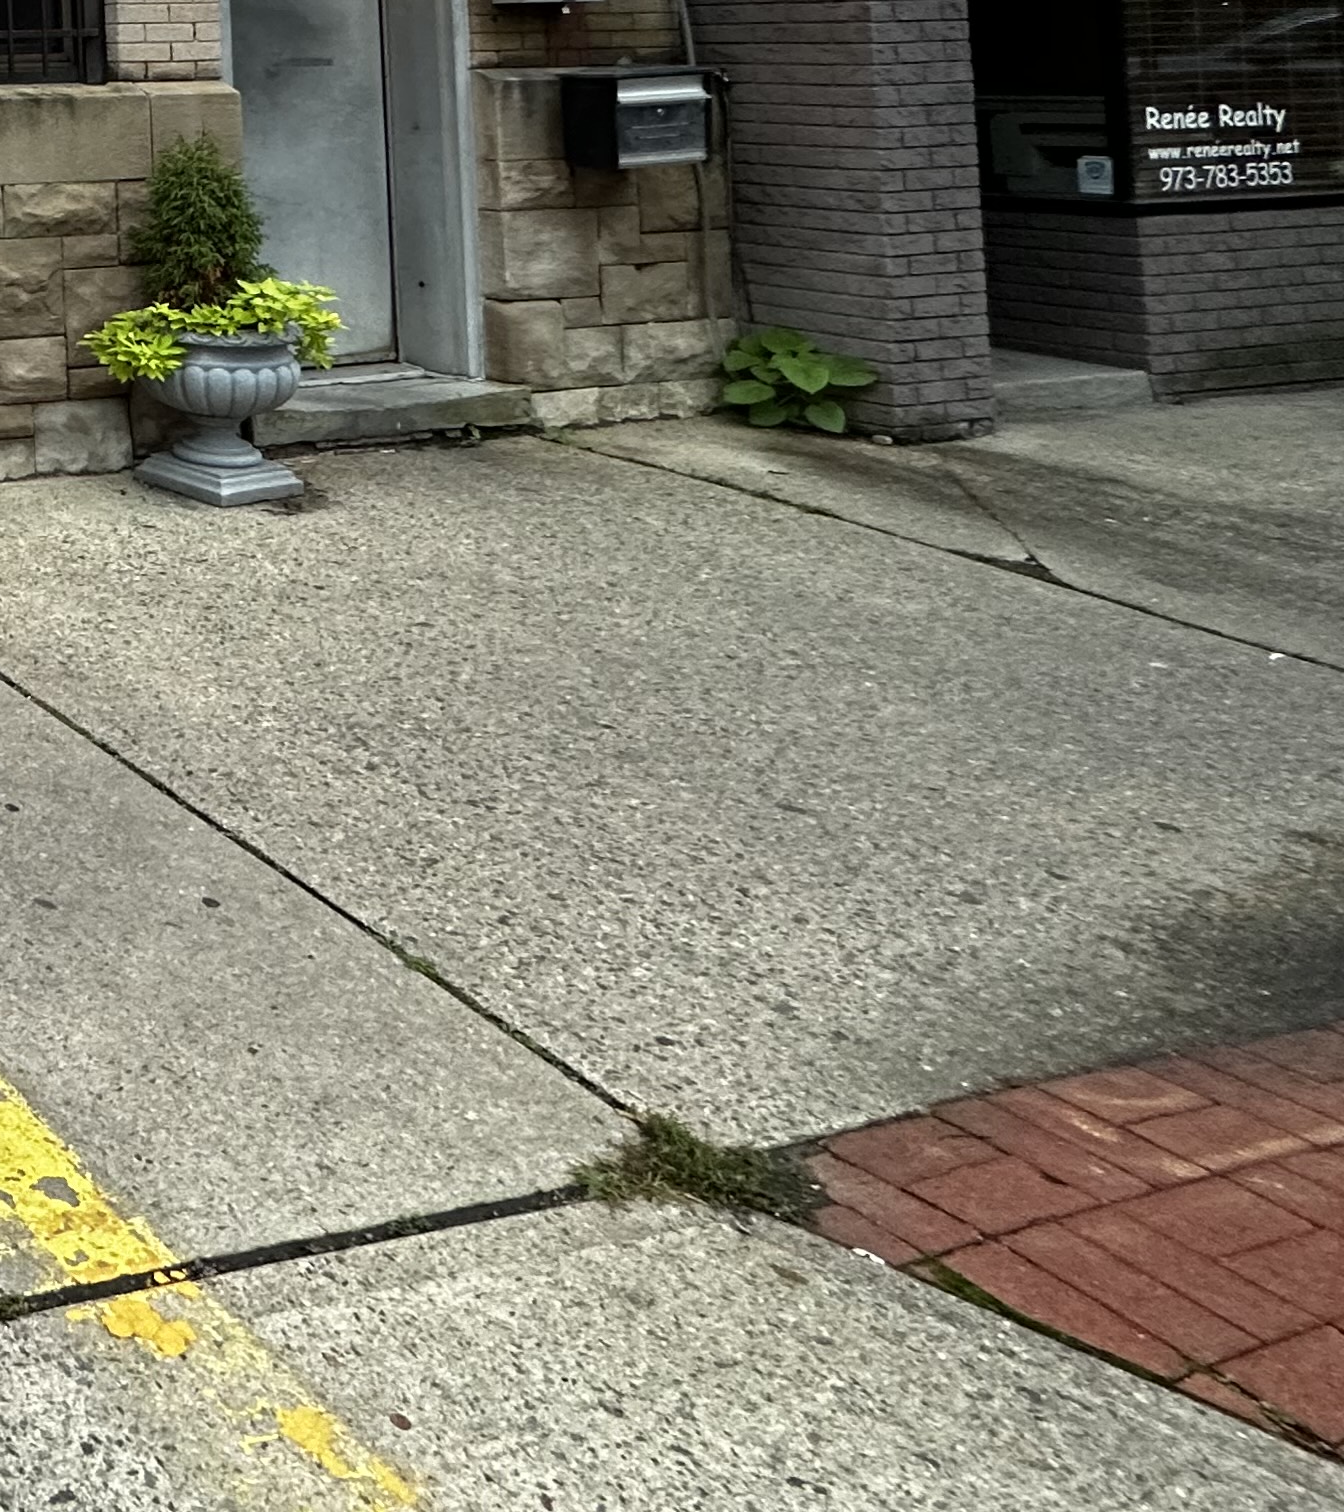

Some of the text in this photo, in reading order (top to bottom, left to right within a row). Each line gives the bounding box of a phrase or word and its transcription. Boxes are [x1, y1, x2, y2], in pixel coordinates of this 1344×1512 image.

[1145, 101, 1287, 133] Renée Realty
[1159, 161, 1293, 192] 973-783-5353
